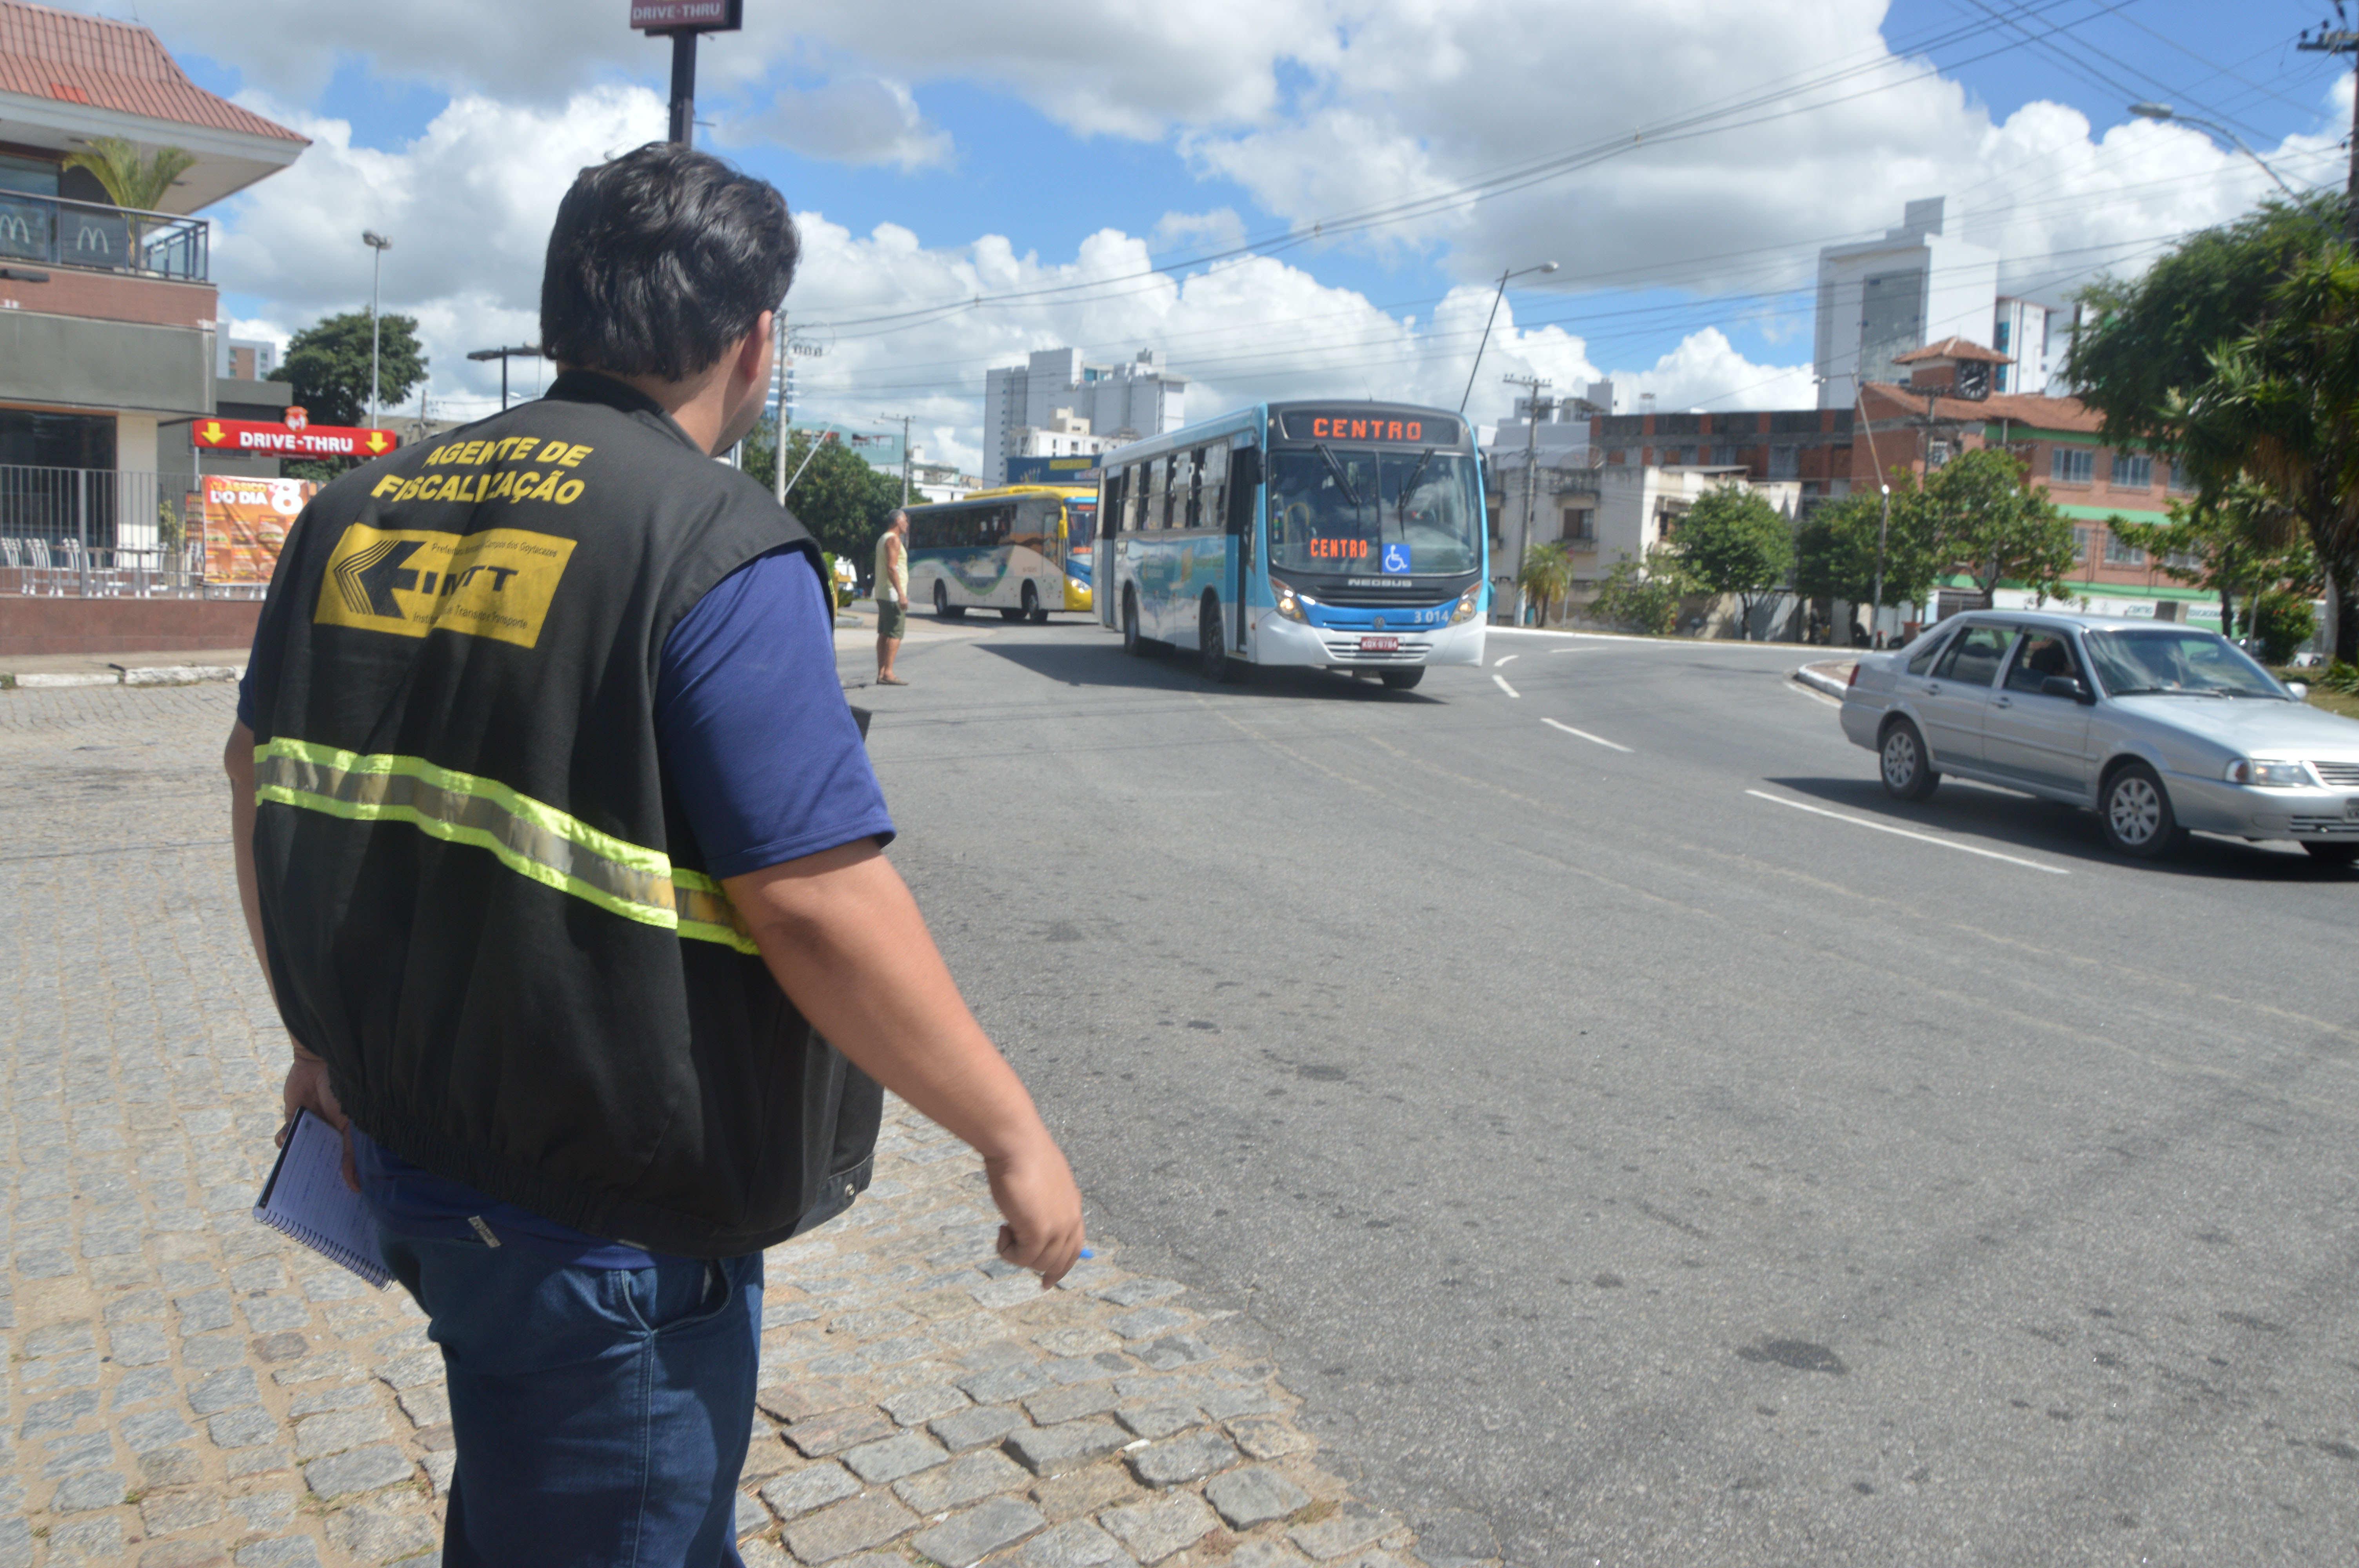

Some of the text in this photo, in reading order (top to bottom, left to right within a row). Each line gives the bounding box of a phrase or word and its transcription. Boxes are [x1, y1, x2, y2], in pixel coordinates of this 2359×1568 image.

[1314, 418, 1421, 440] CENTRO
[240, 431, 353, 452] DRIVE-THRU
[422, 436, 594, 469] AGENTE DE
[210, 490, 235, 504] DO
[239, 491, 268, 505] DIA
[271, 478, 303, 515] 8
[370, 470, 585, 505] FISCALIZAÇÃO
[506, 540, 518, 550] dos
[1310, 538, 1367, 558] CENTRO
[1348, 578, 1412, 588] NEOBUS
